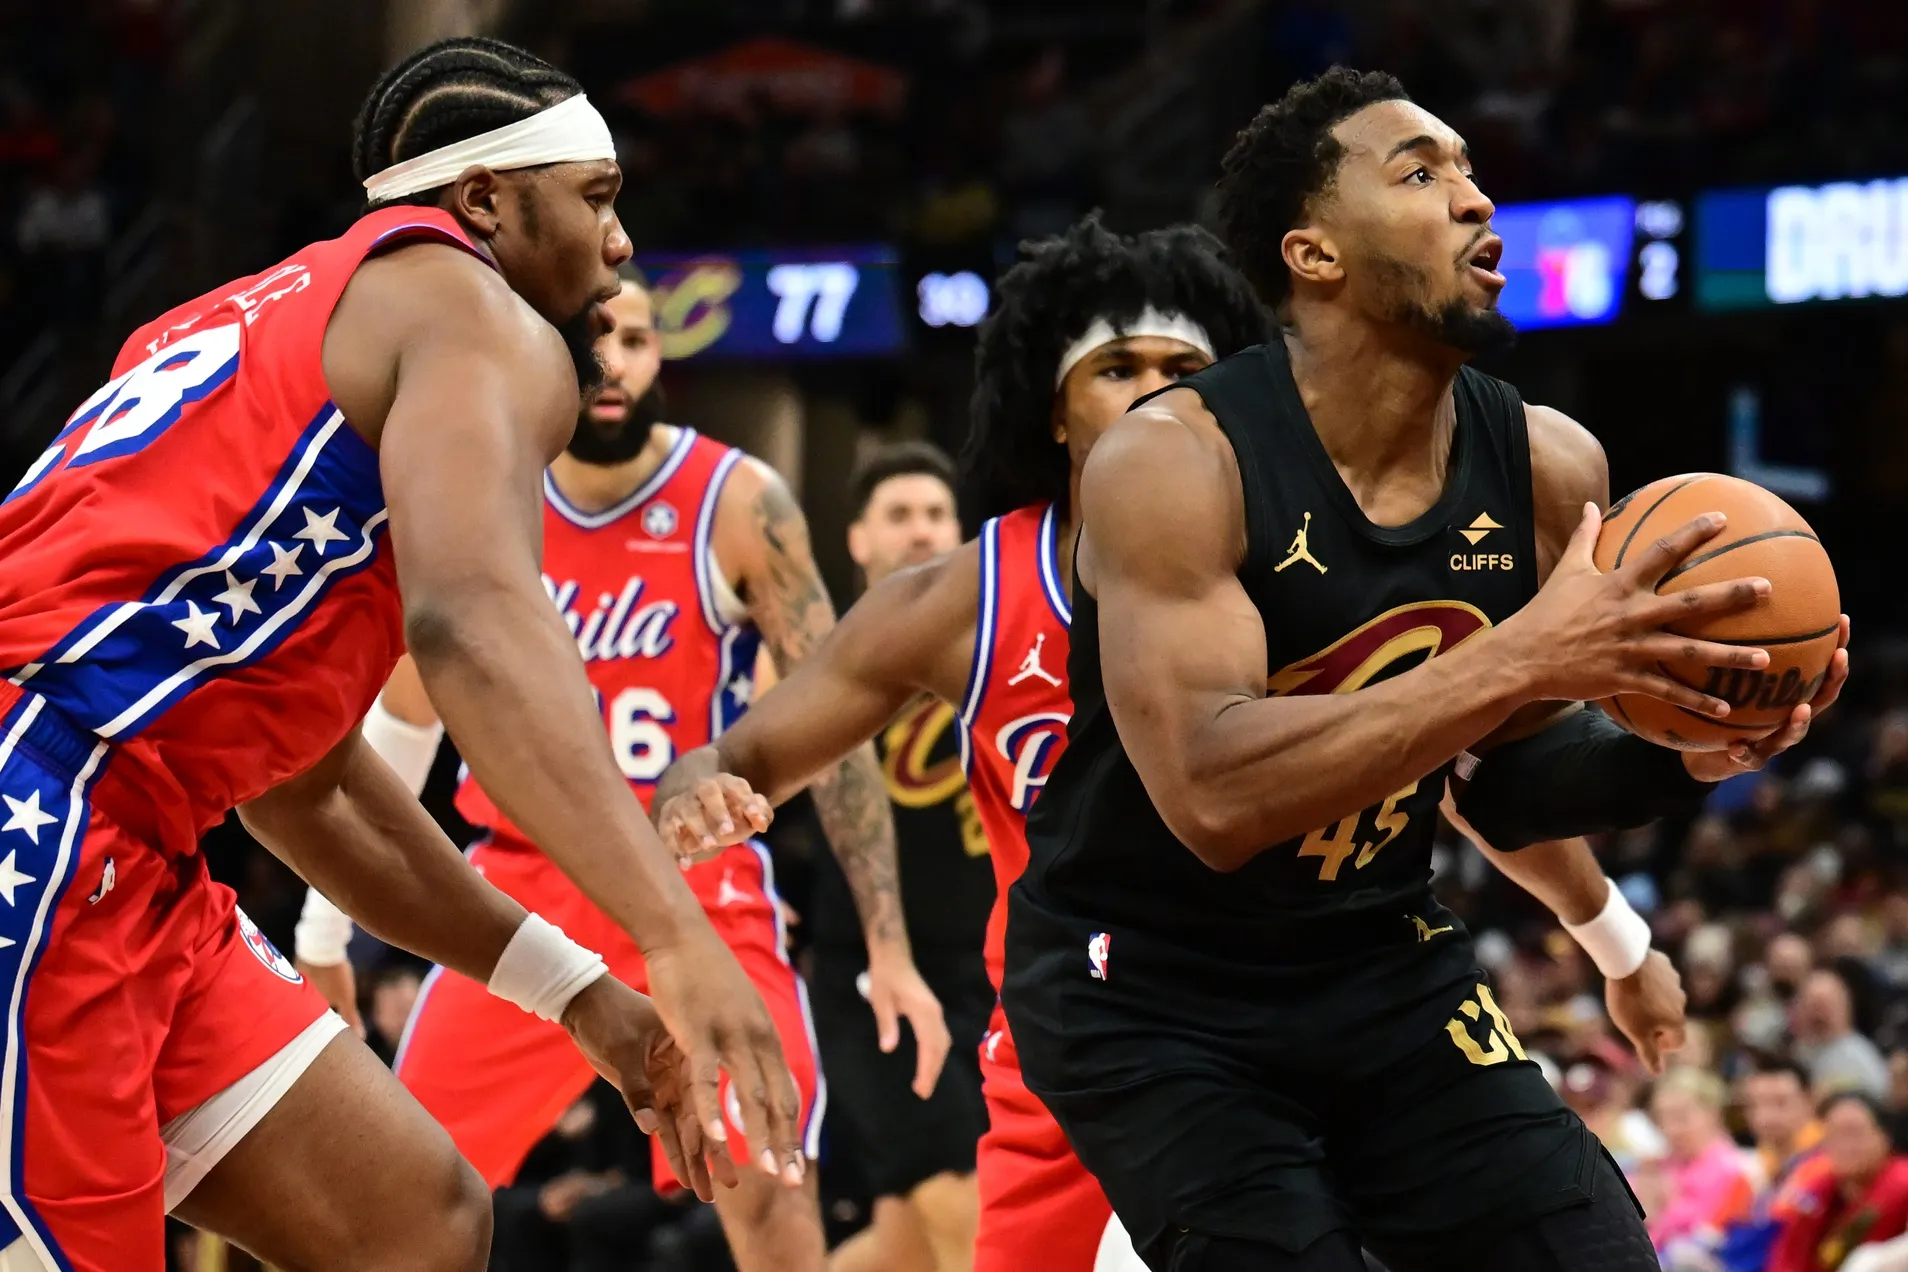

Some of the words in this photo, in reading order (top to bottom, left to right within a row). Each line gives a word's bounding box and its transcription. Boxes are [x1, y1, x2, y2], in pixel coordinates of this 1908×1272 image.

[766, 262, 860, 344] 77
[1450, 554, 1514, 571] CLIFFS
[592, 687, 677, 785] 6
[1298, 781, 1420, 881] 45
